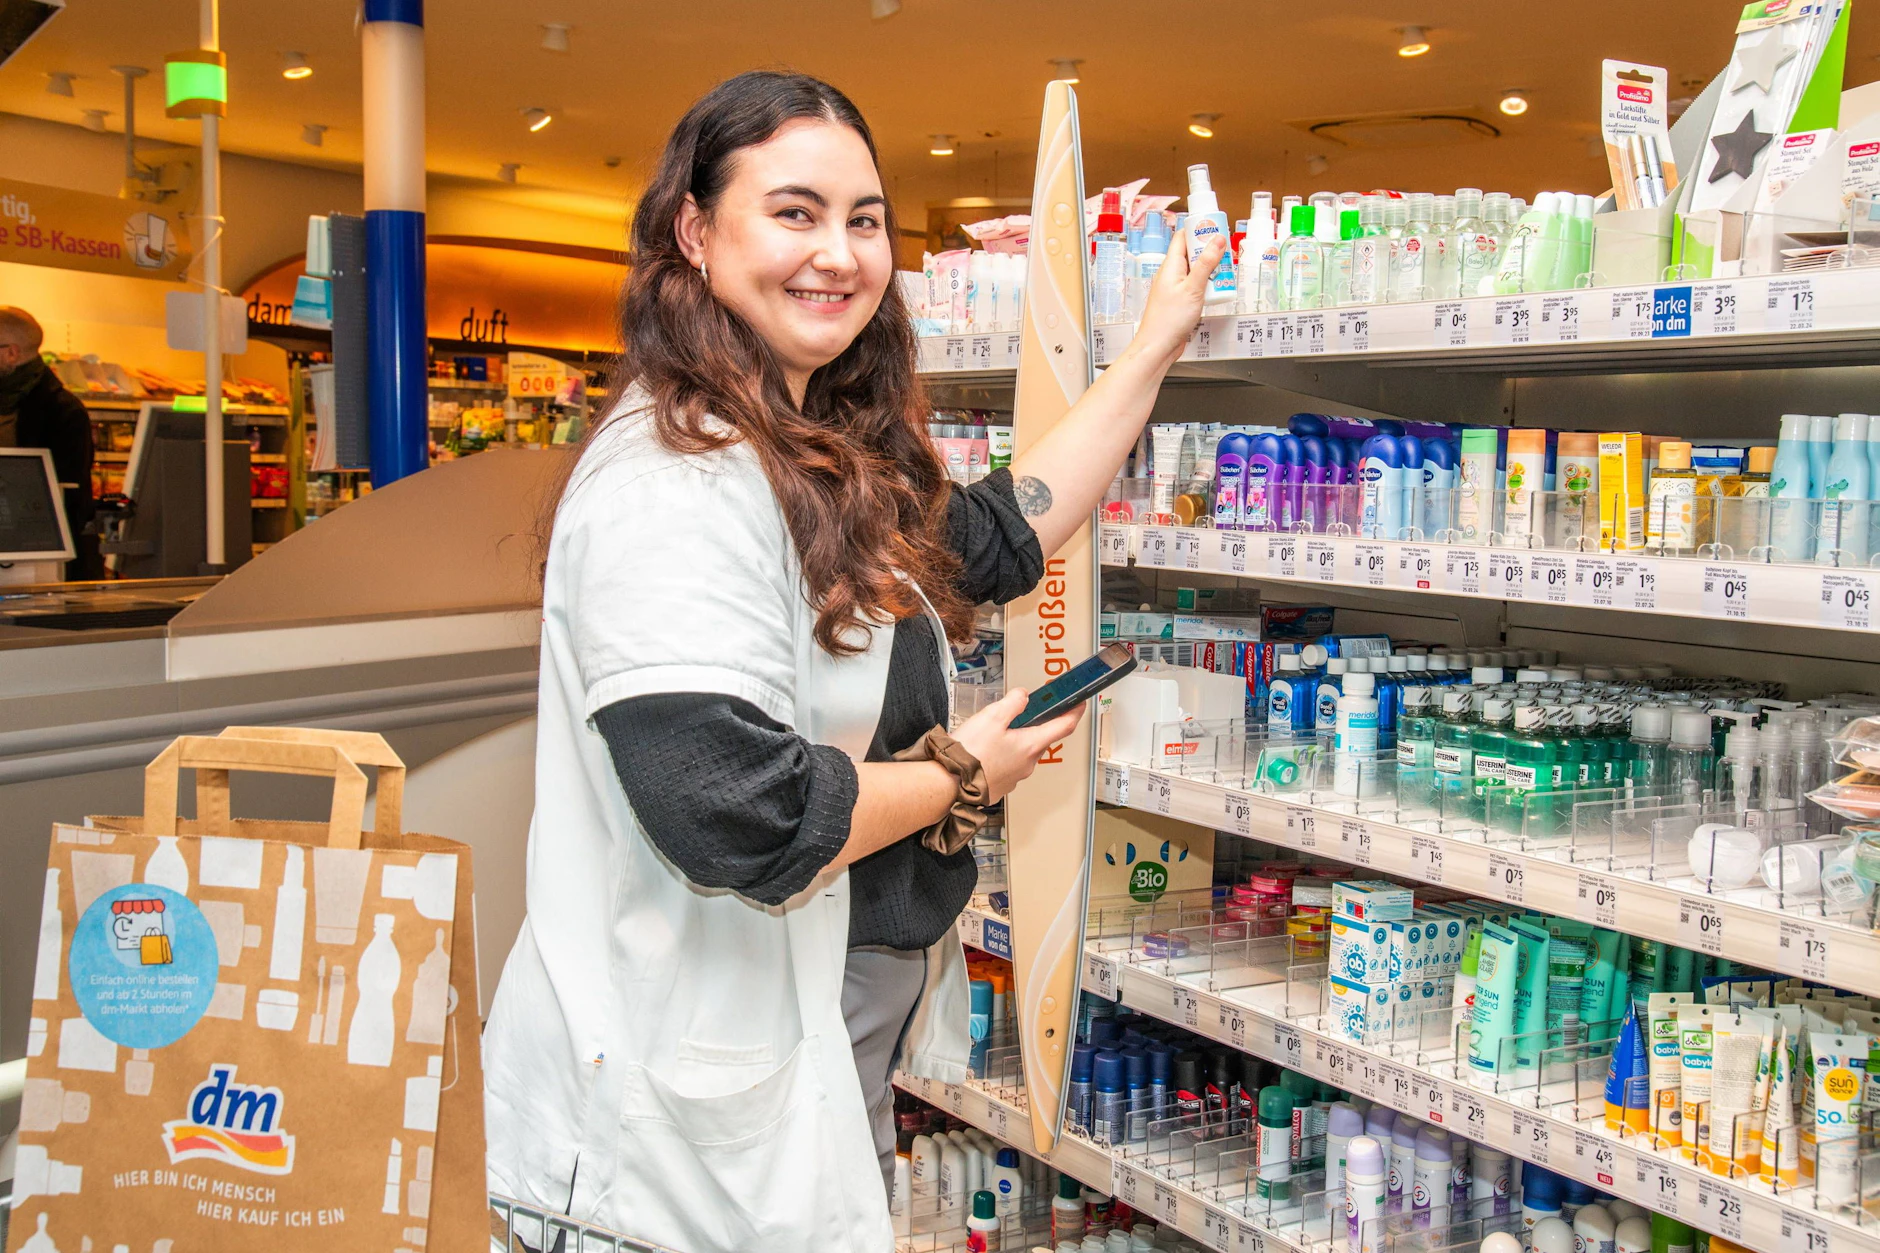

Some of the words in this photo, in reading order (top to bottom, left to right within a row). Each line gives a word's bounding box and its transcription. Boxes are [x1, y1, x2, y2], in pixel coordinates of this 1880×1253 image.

[1620, 91, 1649, 101] Profissimo
[1617, 111, 1629, 120] Gold
[1644, 116, 1660, 125] Silber
[1194, 226, 1219, 237] SAGROTAN
[15, 225, 121, 259] SB-Kassen
[1654, 296, 1686, 315] arke
[461, 307, 508, 342] duft
[1666, 316, 1686, 331] dm
[1272, 610, 1298, 618] Colgate
[1038, 559, 1070, 764] Rgrößen
[1348, 711, 1377, 719] meridol
[1166, 745, 1194, 754] elmex
[1138, 868, 1165, 888] Bio
[987, 925, 1008, 941] Marke
[987, 940, 998, 949] von
[999, 942, 1008, 954] dm
[90, 974, 125, 985] Einfach
[126, 974, 155, 985] online
[158, 974, 199, 985] bestellen
[1584, 979, 1605, 988] SUN
[97, 990, 113, 1000] und
[117, 990, 129, 1000] ab
[131, 990, 138, 1000] 2
[140, 989, 179, 1000] Stunden
[181, 990, 192, 1000] im
[1484, 988, 1499, 1001] SUN
[192, 1070, 277, 1132] dm
[1599, 1174, 1612, 1184] NEU
[114, 1170, 149, 1188] HIER
[154, 1170, 178, 1187] BIN
[183, 1174, 207, 1192] ICH
[212, 1179, 275, 1203] MENSCH
[197, 1200, 232, 1221] HIER
[238, 1208, 279, 1226] KAUF
[285, 1211, 311, 1226] ICH
[318, 1208, 345, 1225] EIN
